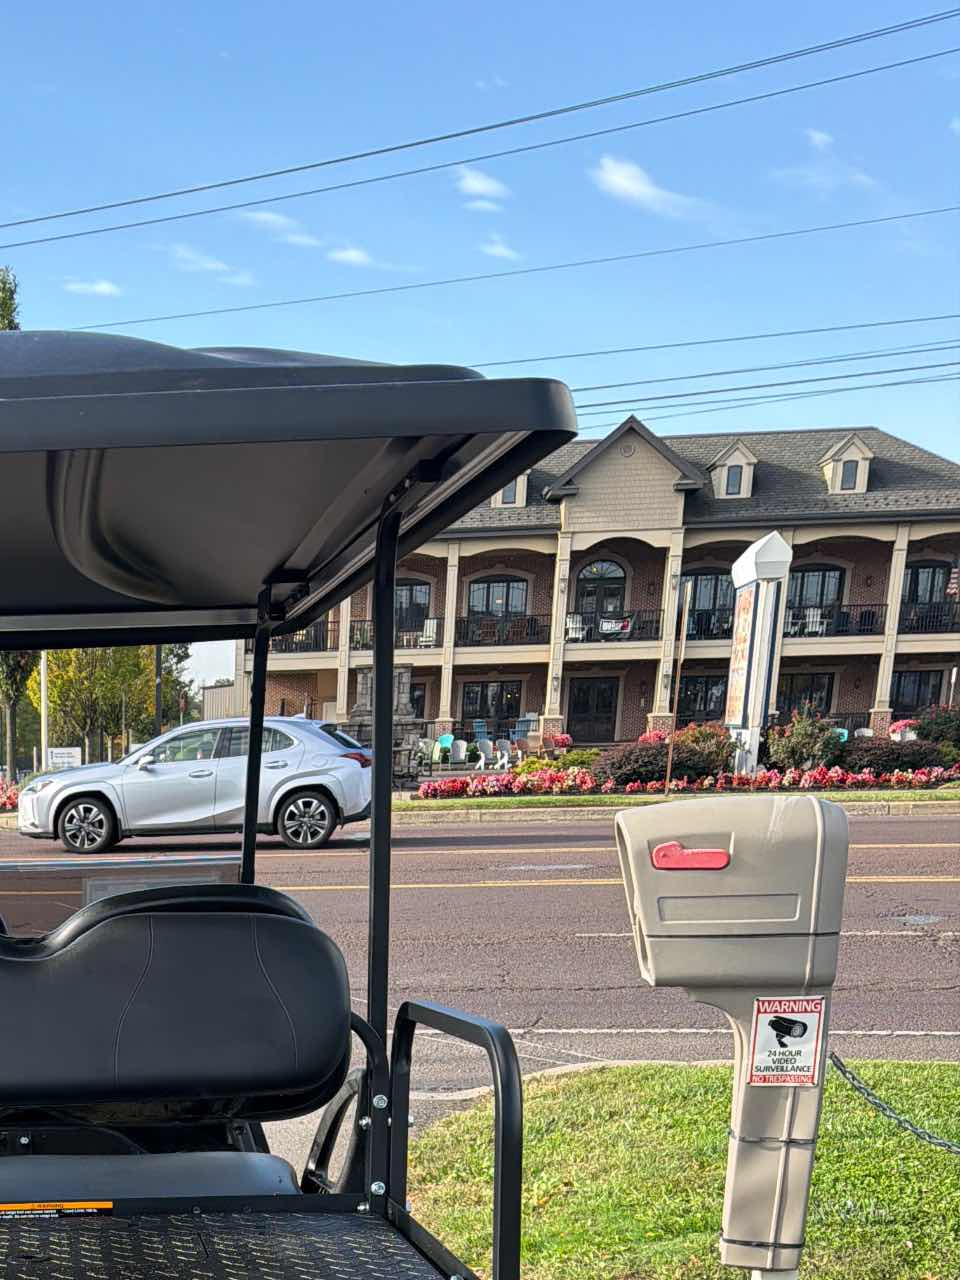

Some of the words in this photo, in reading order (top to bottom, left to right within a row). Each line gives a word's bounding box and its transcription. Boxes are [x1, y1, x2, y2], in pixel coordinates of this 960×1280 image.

[759, 1000, 821, 1013] WARNING
[752, 1075, 764, 1083] NO
[766, 1075, 812, 1083] TRESPASSING
